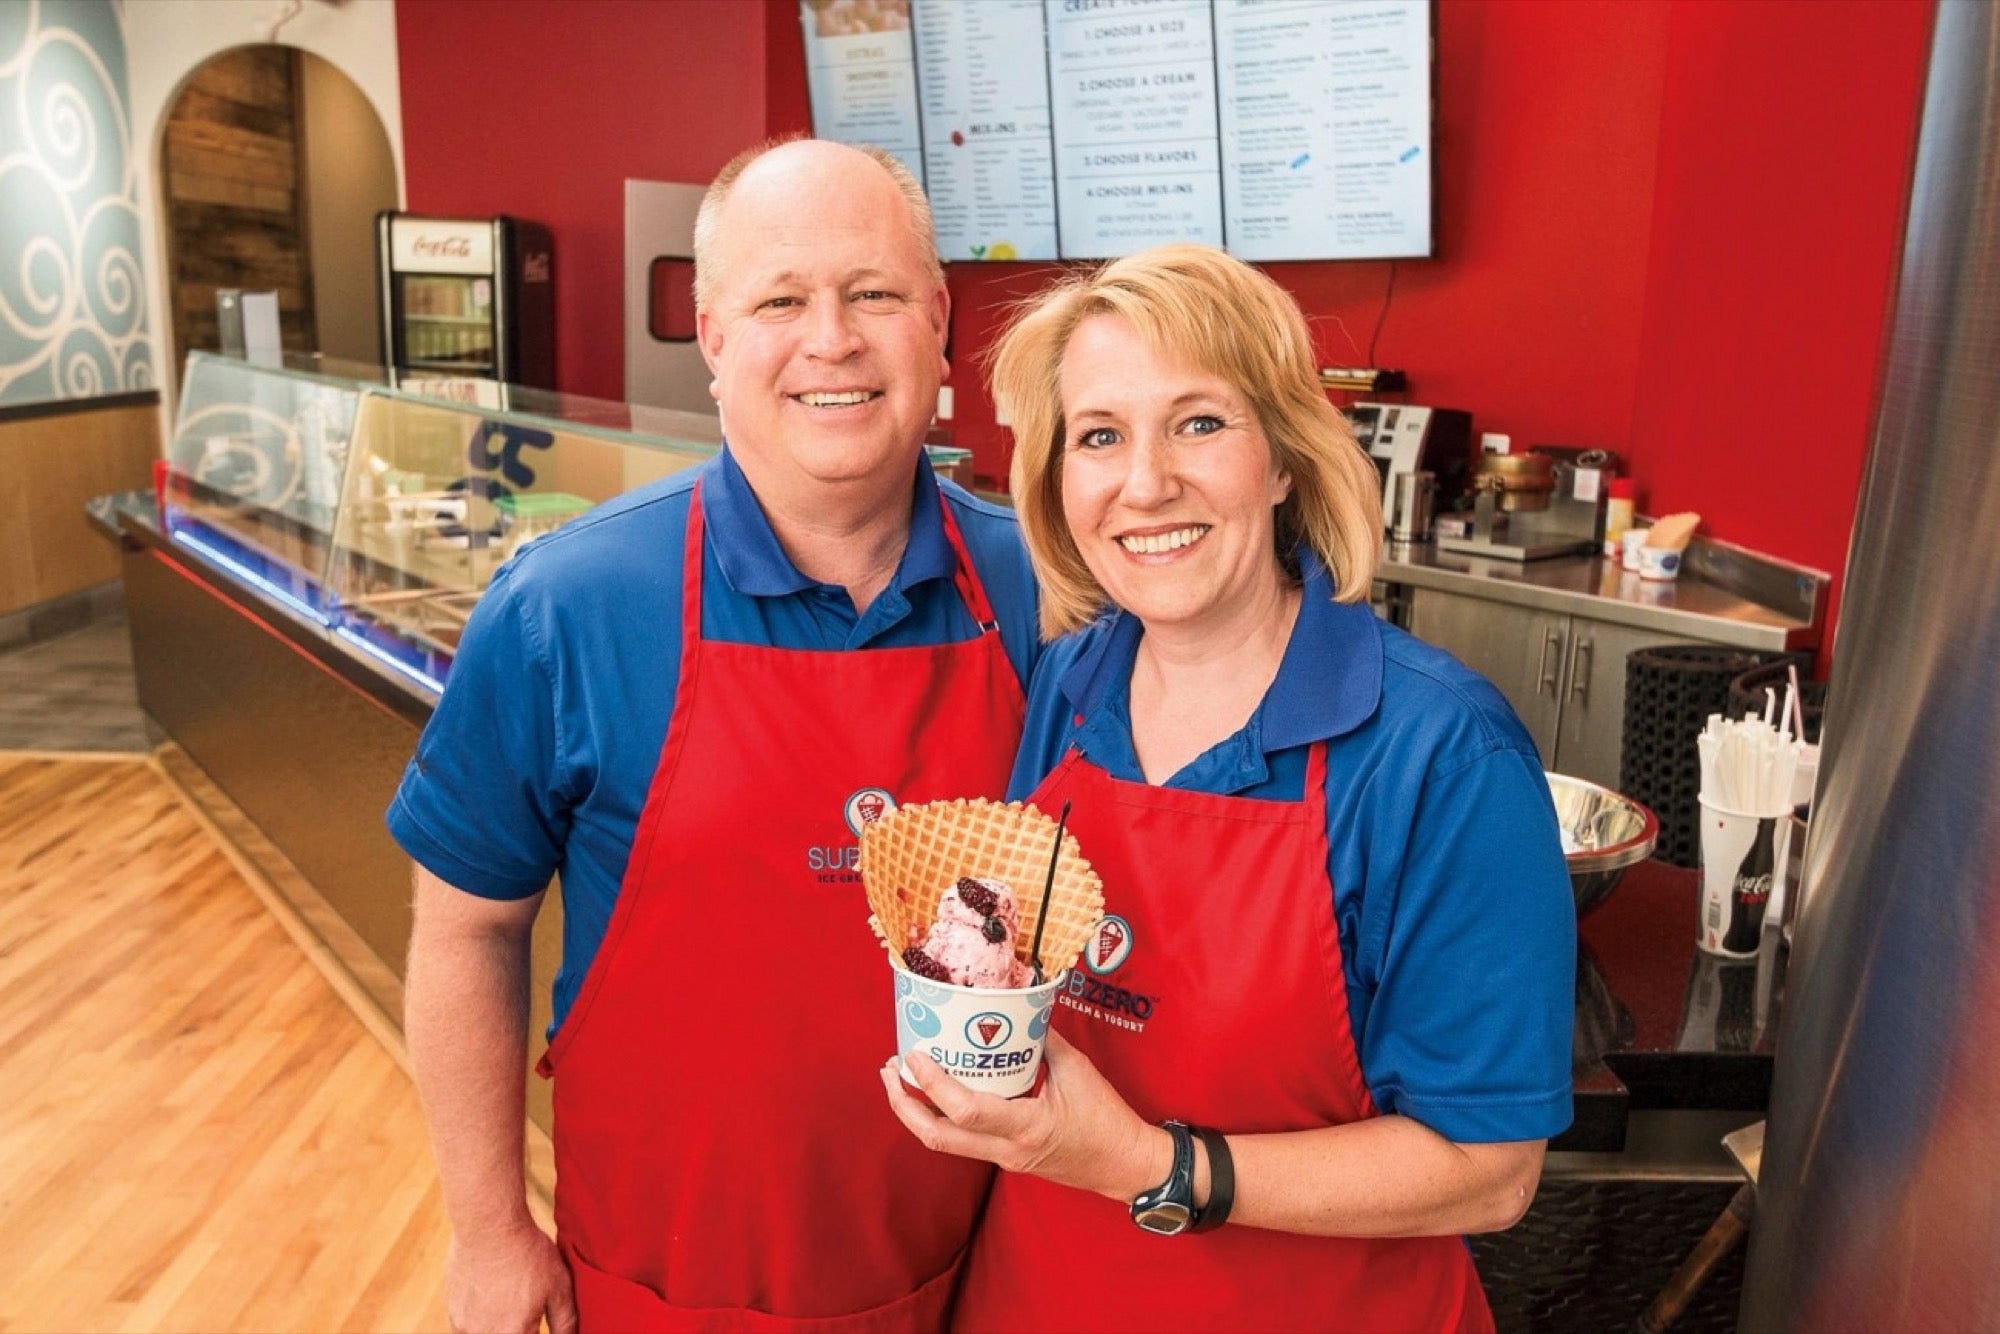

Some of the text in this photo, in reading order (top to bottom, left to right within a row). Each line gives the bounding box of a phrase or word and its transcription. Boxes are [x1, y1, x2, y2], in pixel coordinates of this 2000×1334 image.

[1160, 20, 1185, 33] SIZE
[1154, 72, 1196, 85] CREAM
[1144, 150, 1198, 163] FLAVORS
[1059, 995, 1144, 1033] CREAM & YOGURT
